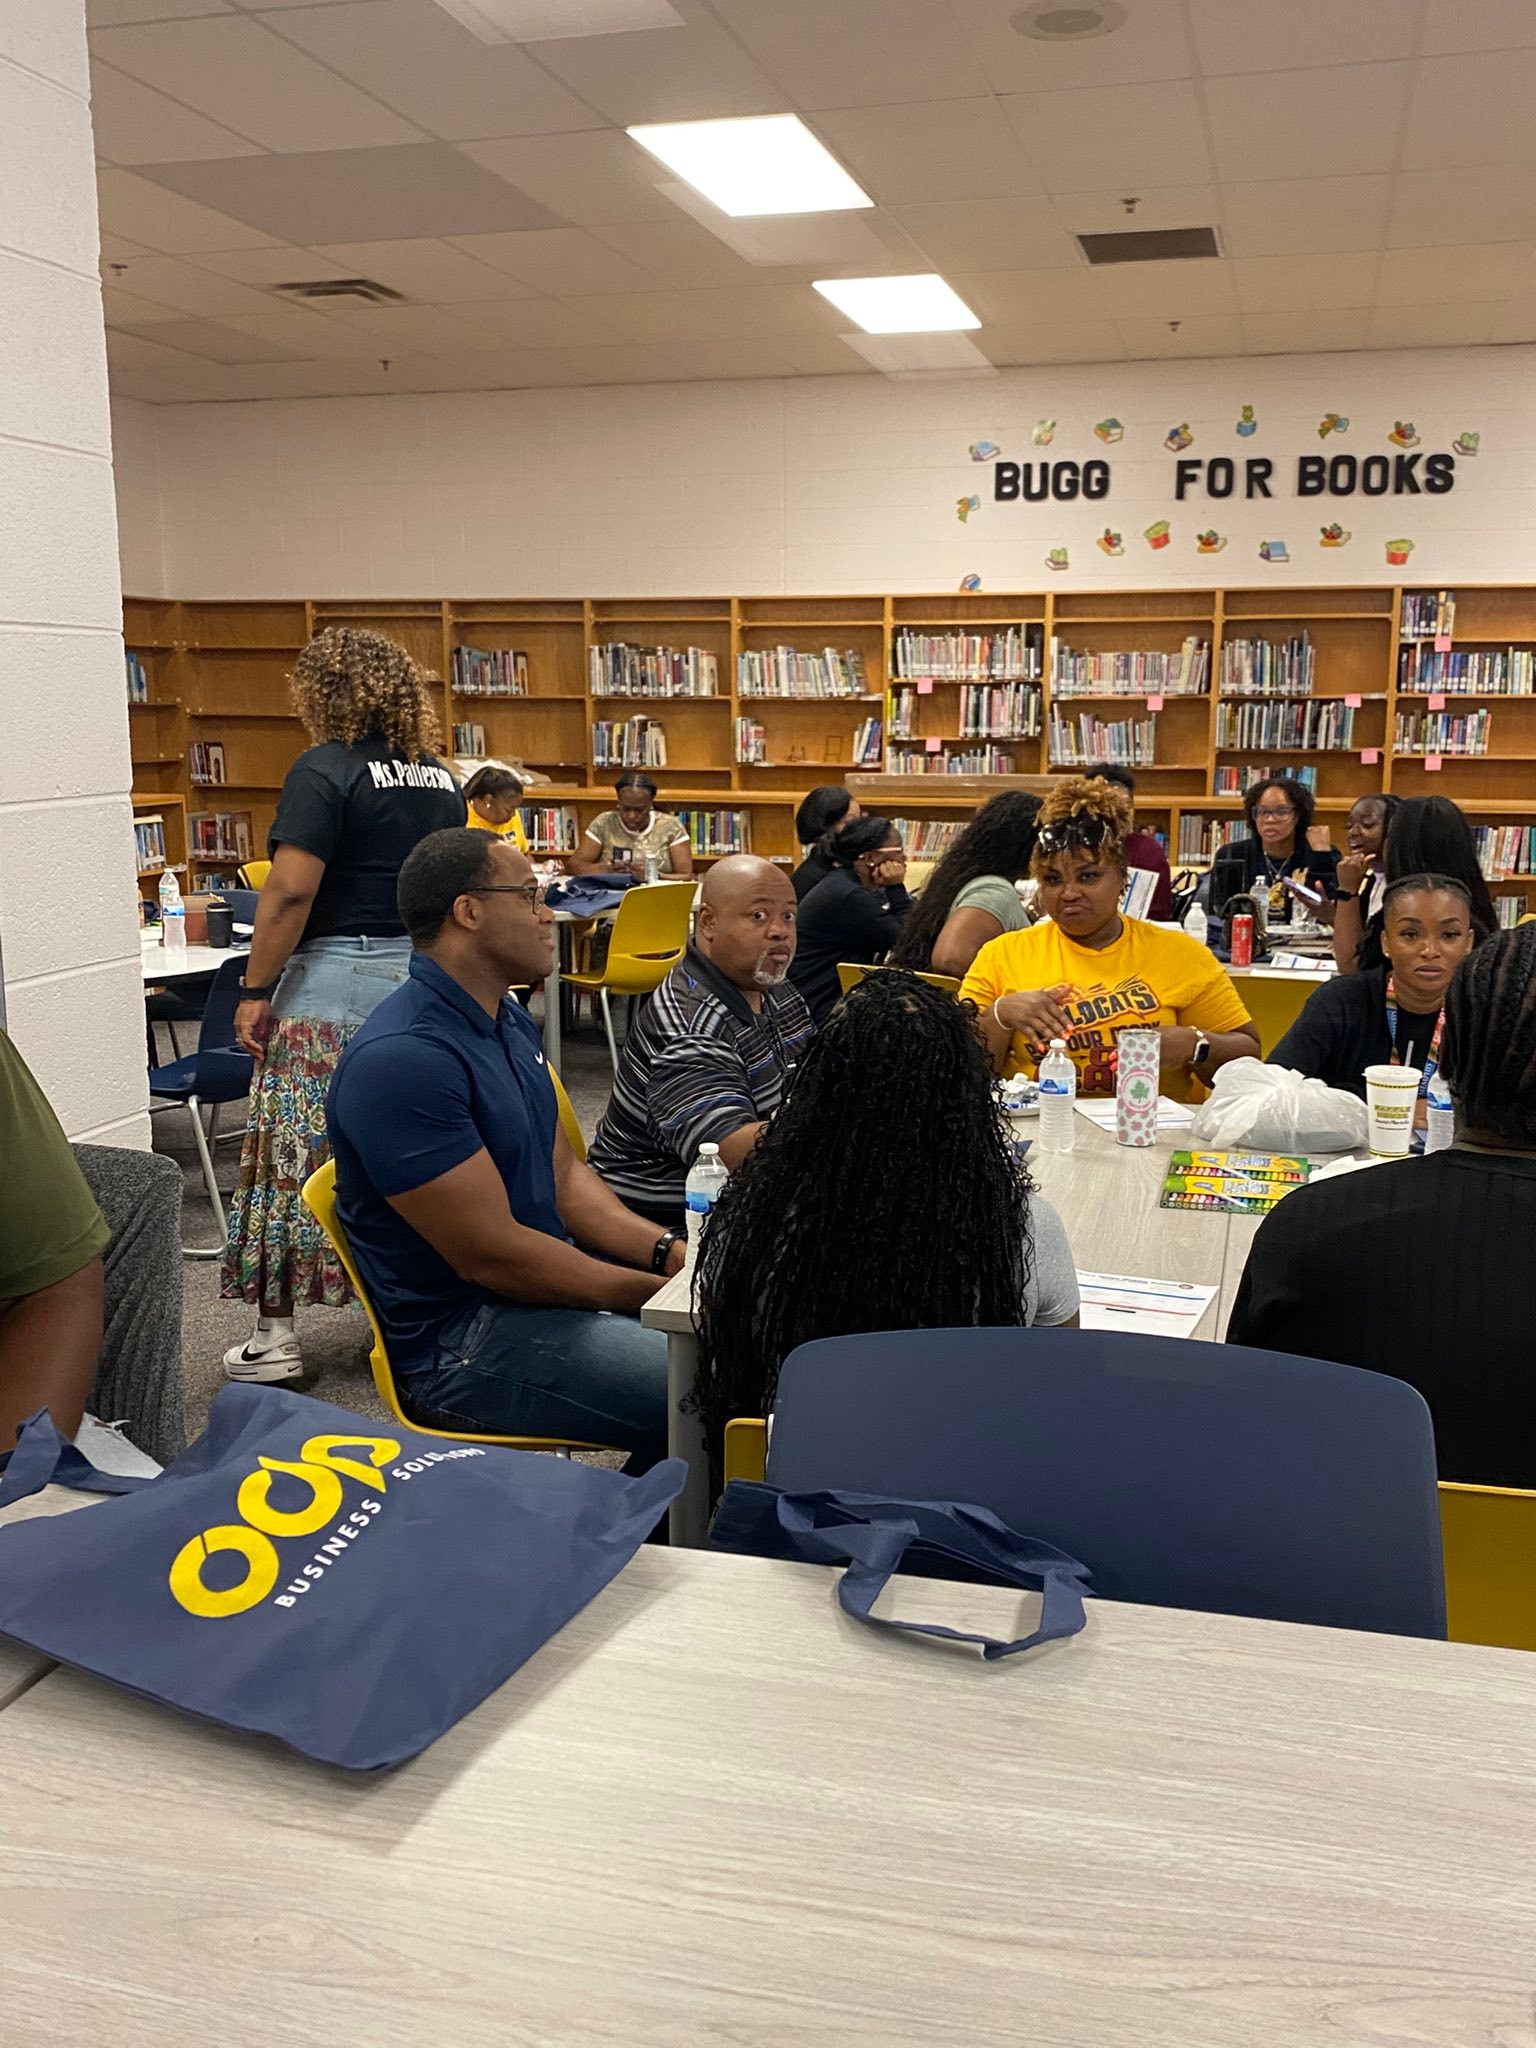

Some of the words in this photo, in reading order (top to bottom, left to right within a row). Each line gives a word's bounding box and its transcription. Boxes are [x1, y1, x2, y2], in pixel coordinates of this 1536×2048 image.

[994, 459, 1111, 501] BUGG
[1175, 457, 1273, 500] FOR
[1297, 453, 1456, 496] BOOKS
[1063, 985, 1157, 1026] LDCATS
[274, 1498, 381, 1609] BUSINESS
